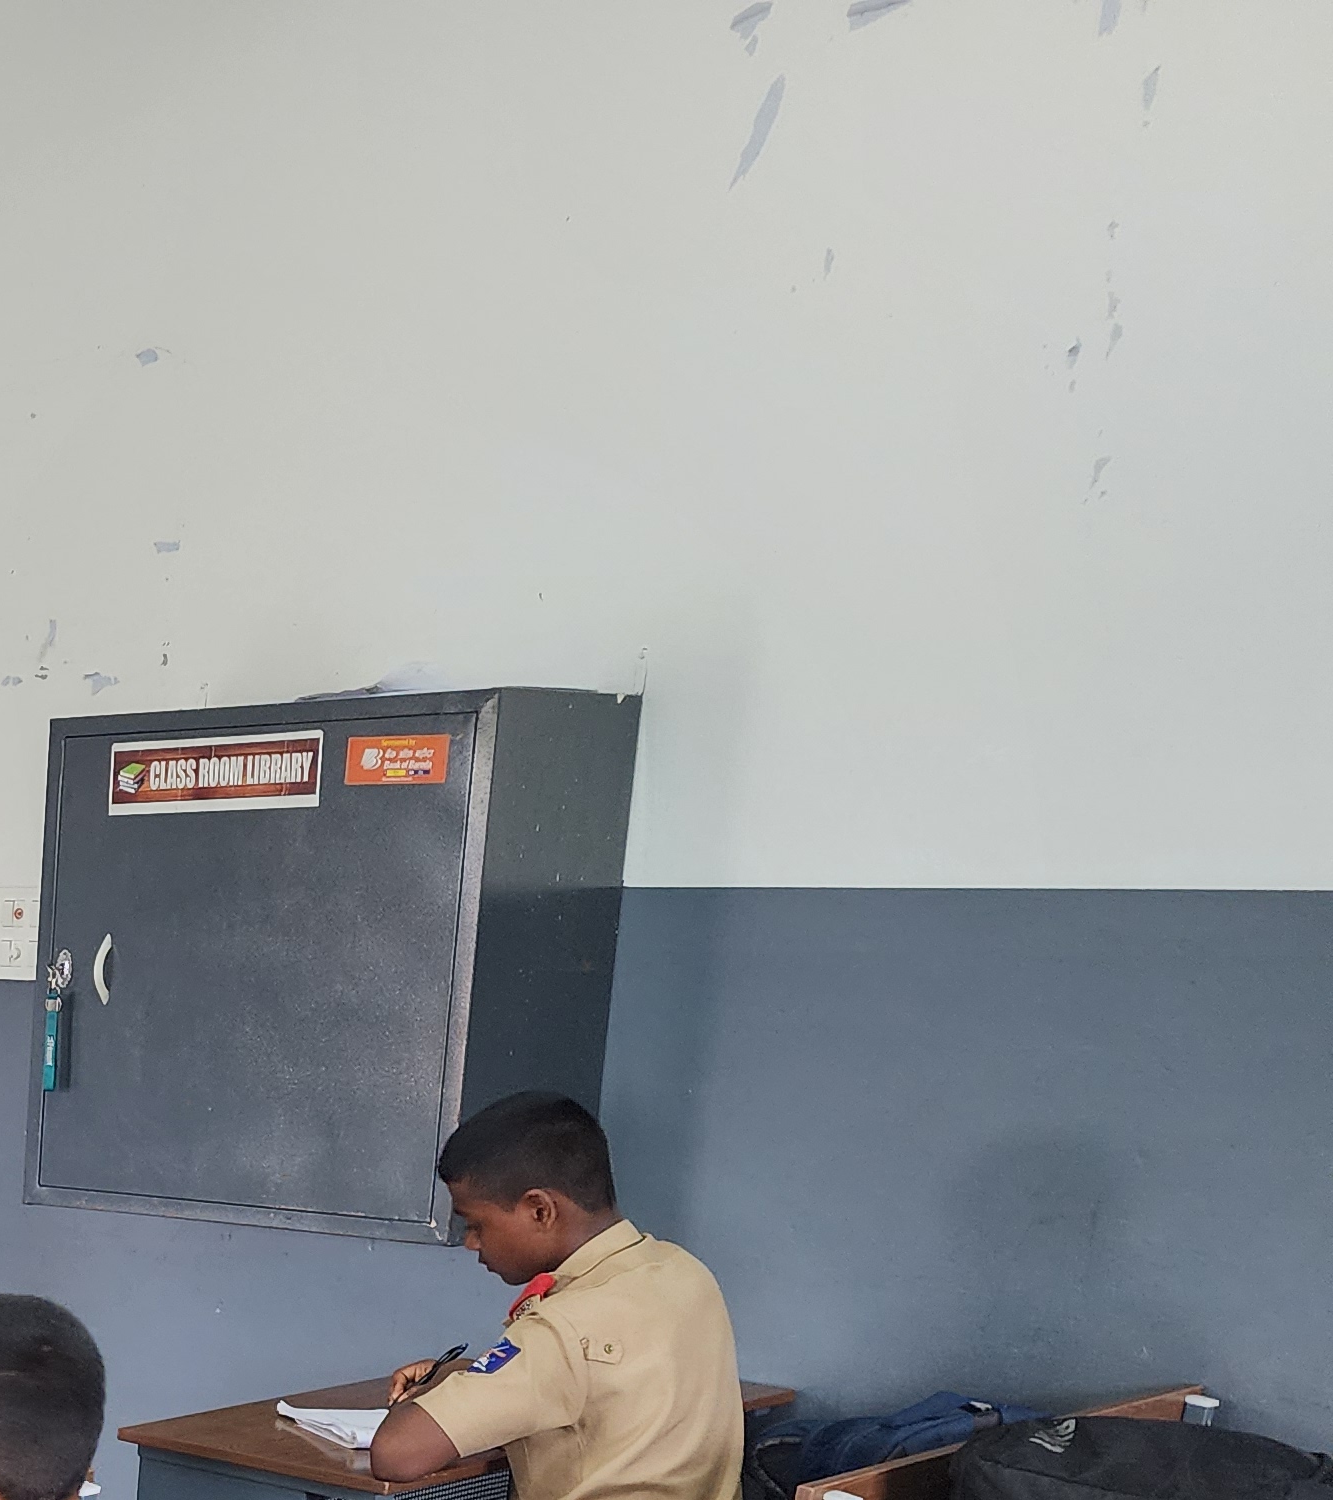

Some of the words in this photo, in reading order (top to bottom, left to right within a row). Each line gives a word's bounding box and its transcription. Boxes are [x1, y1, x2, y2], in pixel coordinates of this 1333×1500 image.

[149, 758, 196, 791] CLASS
[198, 755, 244, 788] ROOM
[245, 751, 314, 786] LIBRARY
